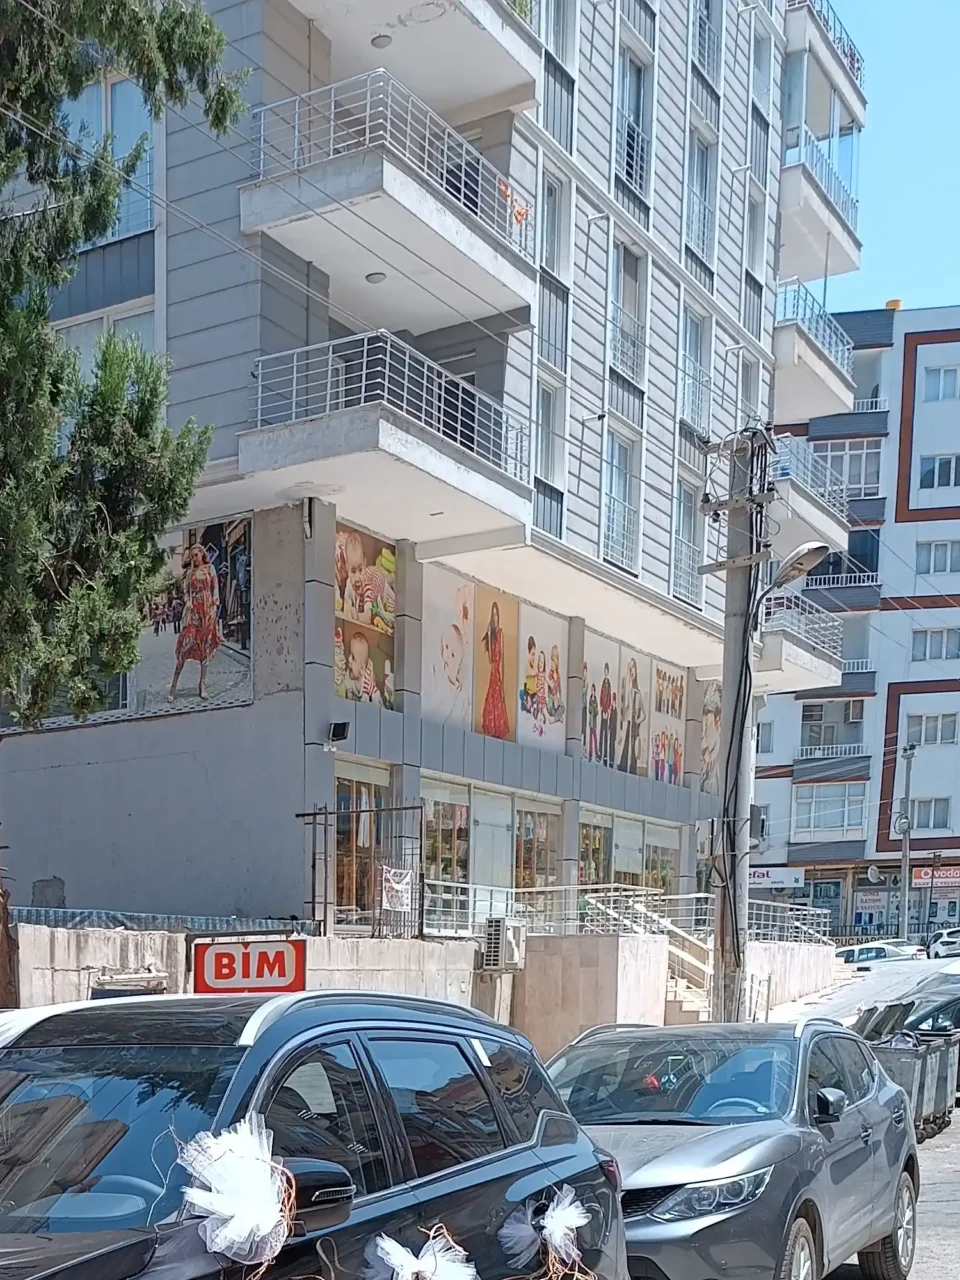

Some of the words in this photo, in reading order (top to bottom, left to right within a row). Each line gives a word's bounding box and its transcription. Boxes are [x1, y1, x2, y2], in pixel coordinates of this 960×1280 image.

[748, 870, 772, 879] efal
[933, 868, 960, 878] voda
[214, 943, 287, 980] BİM
